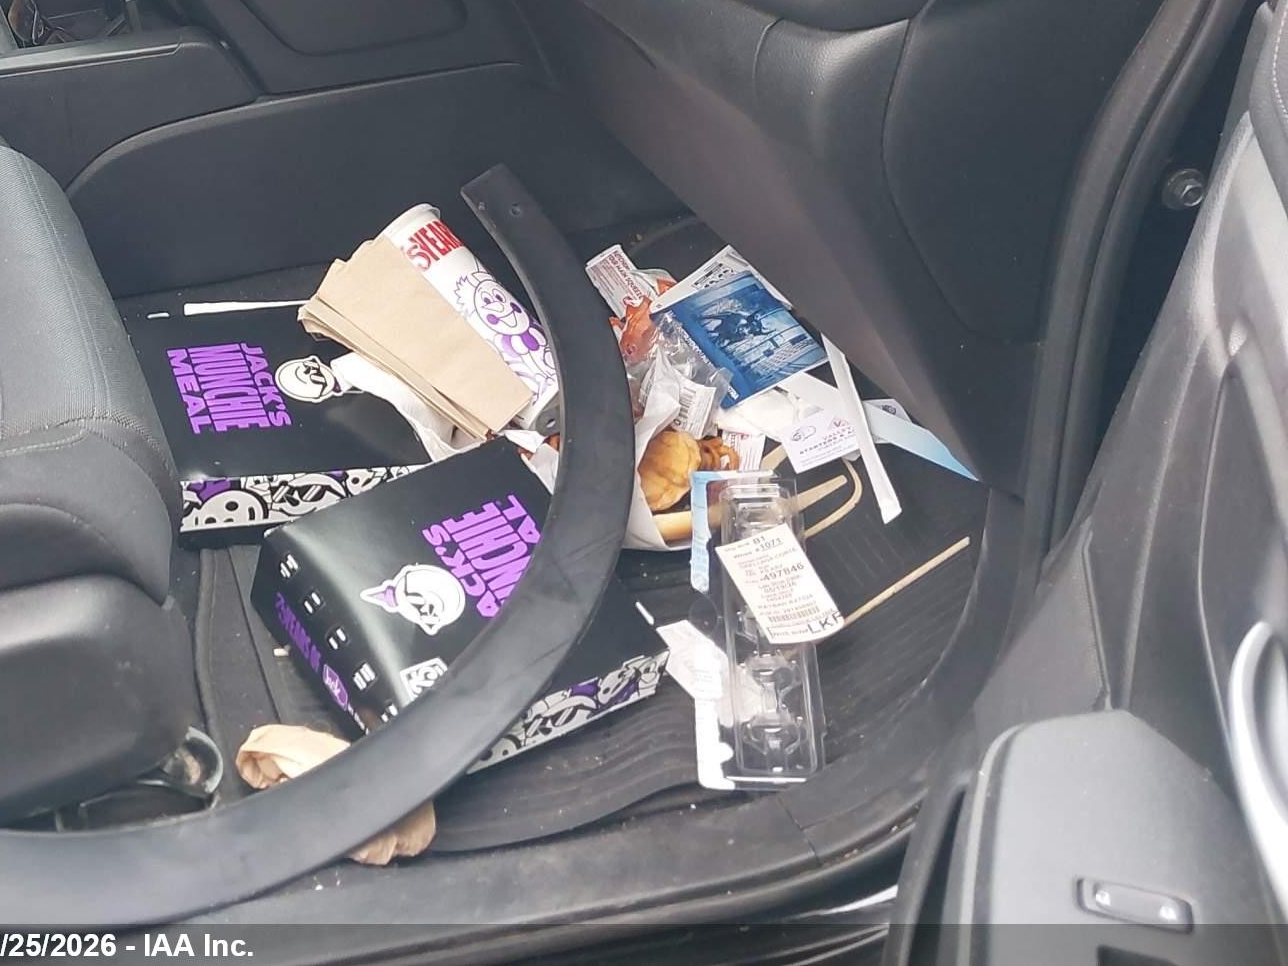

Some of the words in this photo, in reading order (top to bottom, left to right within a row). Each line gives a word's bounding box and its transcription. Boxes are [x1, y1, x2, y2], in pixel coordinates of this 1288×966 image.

[166, 348, 213, 435] MEAL
[187, 343, 271, 432] MUNCHIE
[240, 342, 292, 427] JACK'S
[441, 501, 532, 605] NCHIE
[501, 494, 541, 544] AL
[422, 524, 500, 617] ACK'S
